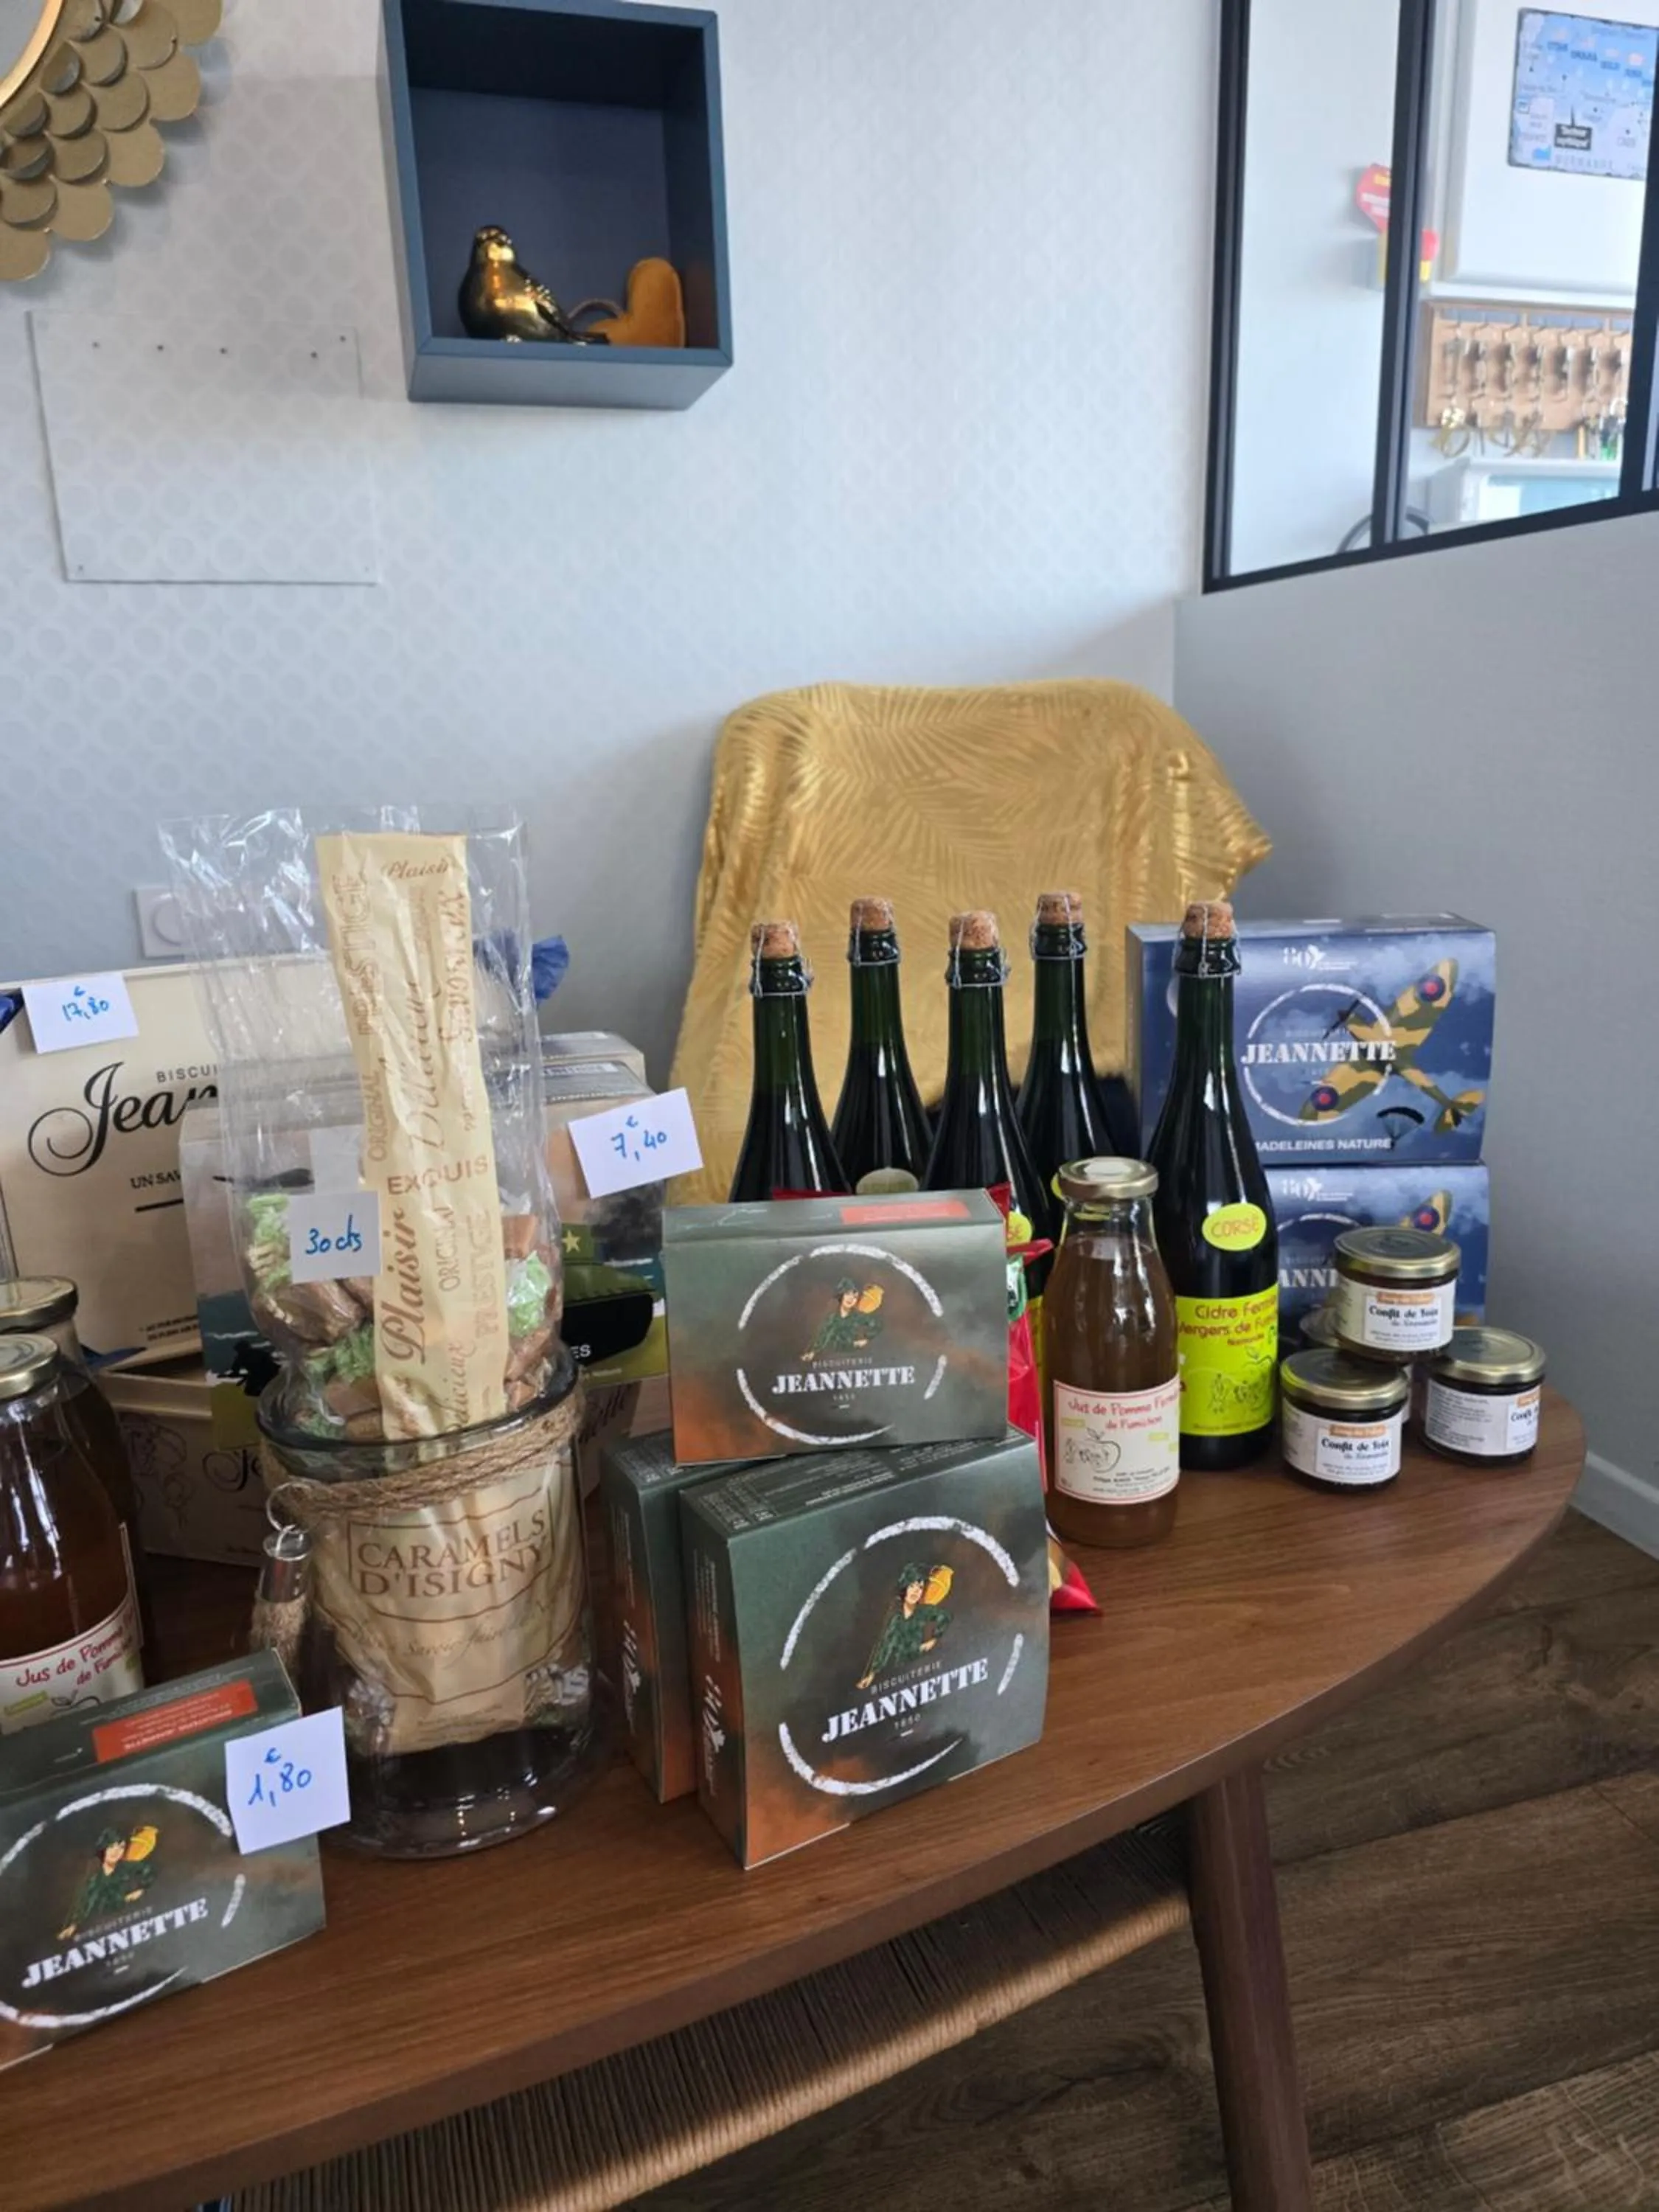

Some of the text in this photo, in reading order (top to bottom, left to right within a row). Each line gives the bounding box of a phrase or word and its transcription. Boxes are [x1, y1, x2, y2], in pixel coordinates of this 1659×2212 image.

[1241, 1040, 1396, 1065] JEANNETTE
[156, 1065, 218, 1084] BISCUI
[611, 1130, 667, 1162] 7,40
[1337, 1137, 1391, 1151] NATURE
[155, 1169, 181, 1185] SAV
[387, 1155, 488, 1196] EXQUIS
[379, 1206, 425, 1365] Plaisir
[1194, 1304, 1239, 1321] Cidre
[771, 1365, 916, 1395] JEANNETTE
[357, 1509, 547, 1571] CARAMELS
[359, 1541, 546, 1599] D'ISIGNY
[15, 1667, 51, 1688] Jus
[56, 1658, 77, 1676] de
[76, 1669, 92, 1686] de
[870, 1660, 942, 1695] BISCUITERIE
[821, 1657, 990, 1744] JEANNETTE
[248, 1762, 313, 1807] 1,80
[21, 1897, 209, 1989] JEANNETTE
